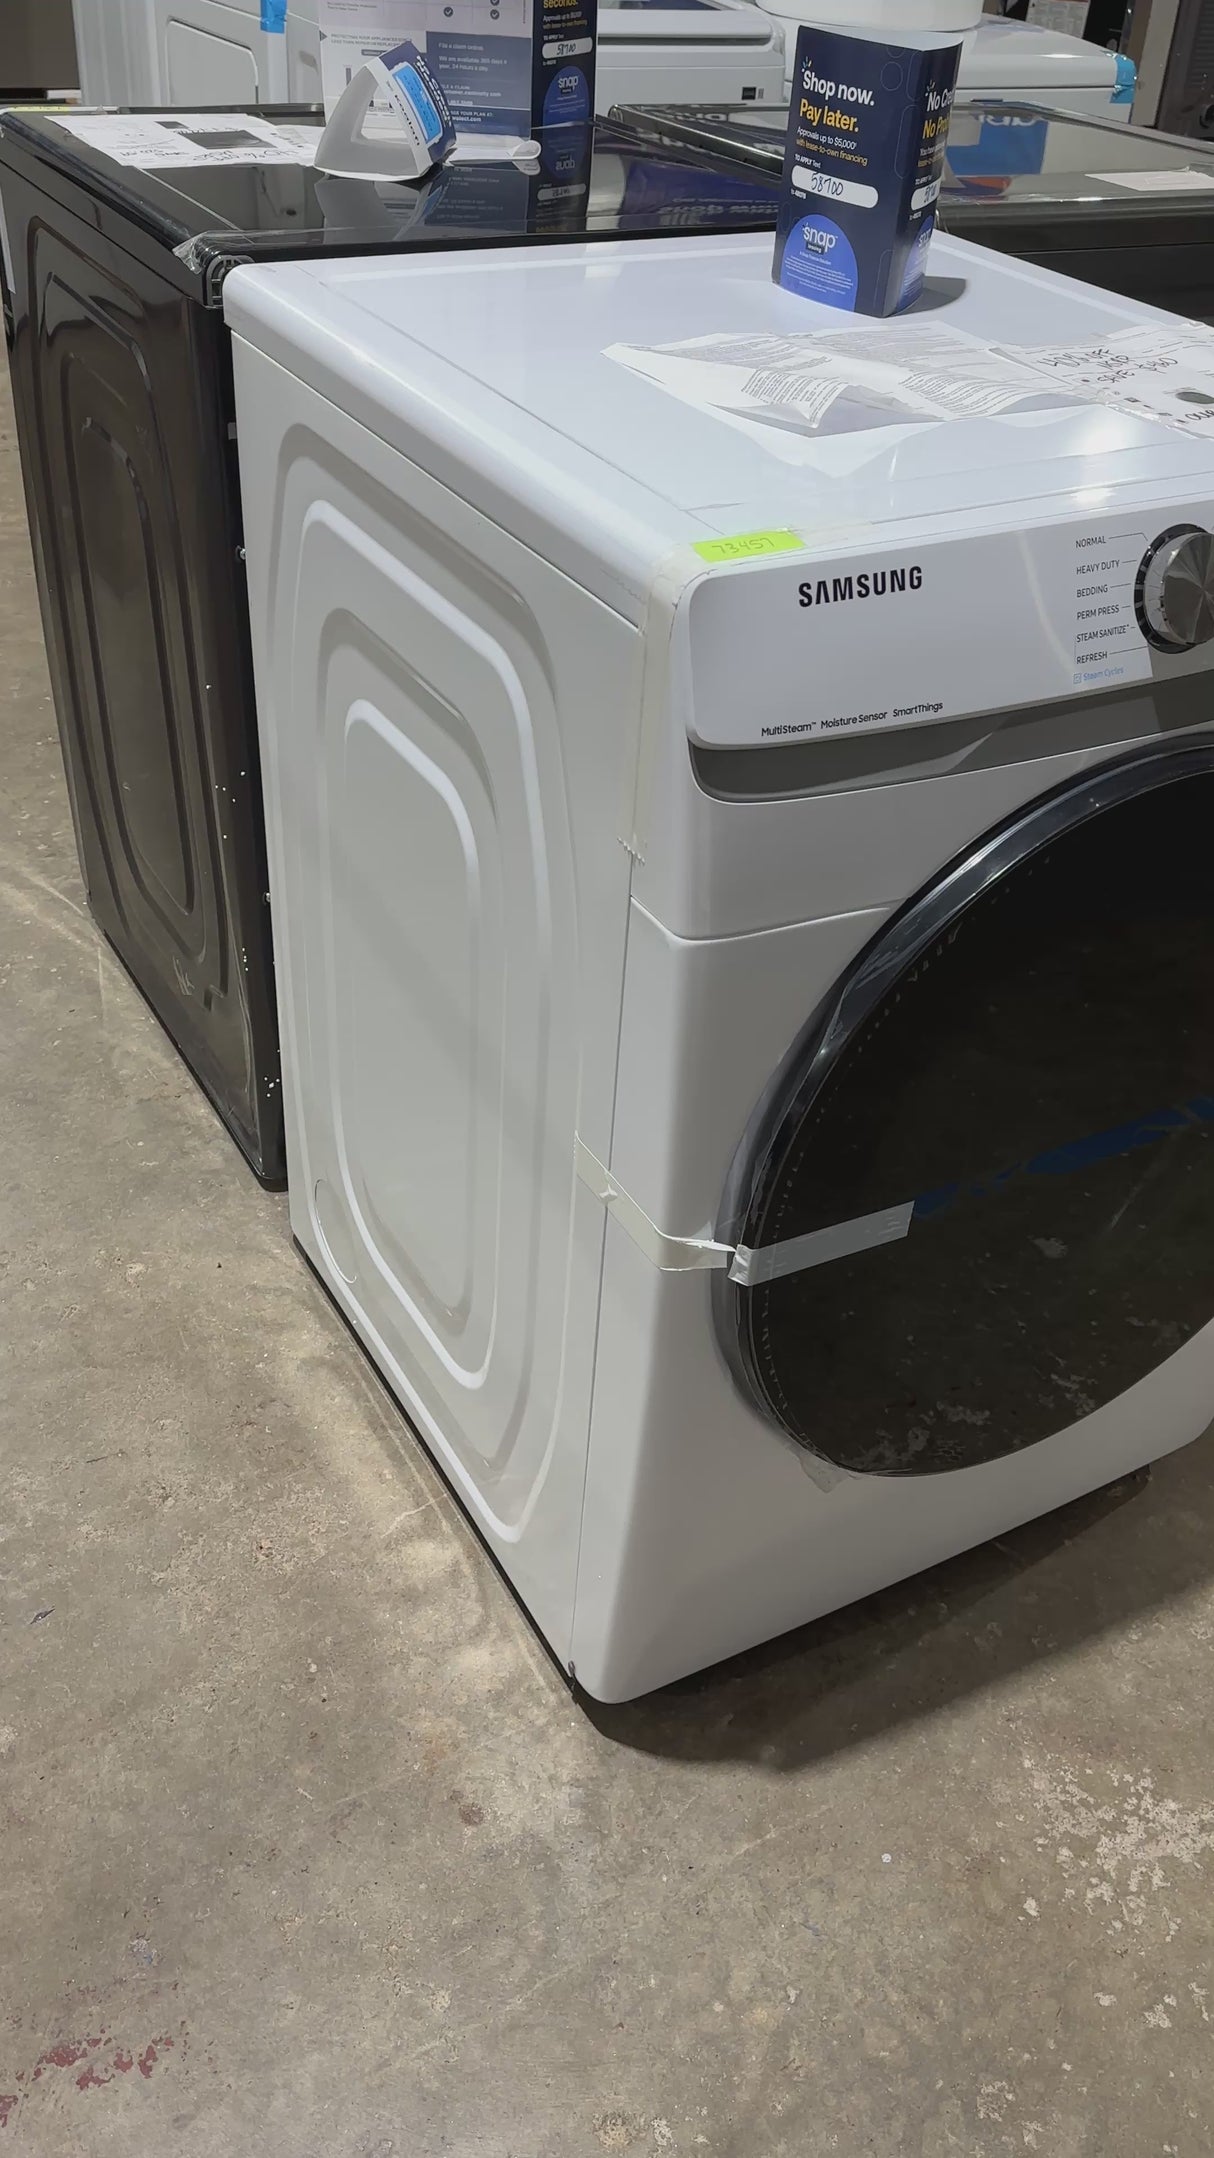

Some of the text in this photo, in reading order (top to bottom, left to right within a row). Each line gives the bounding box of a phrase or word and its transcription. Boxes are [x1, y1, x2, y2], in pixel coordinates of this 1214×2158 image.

[802, 70, 875, 106] Shop now.
[926, 90, 940, 112] No
[800, 99, 860, 132] Pay later.
[797, 126, 820, 141] Approvals
[820, 133, 827, 144] up
[828, 135, 834, 145] to
[922, 118, 936, 140] No
[840, 150, 869, 167] financing
[712, 538, 775, 555] 73457
[1076, 536, 1106, 548] NORMAL
[1076, 560, 1120, 575] HEAVY DUTY
[798, 566, 923, 608] SAMSUNG
[1076, 584, 1108, 598] BEDDING
[1076, 604, 1120, 620] PERM PRESS
[1076, 630, 1099, 643] STEAM
[1076, 652, 1108, 664] REFRESH
[1083, 666, 1124, 681] Steam Cycles
[820, 715, 858, 730] Moisture
[858, 711, 888, 724] Sensor
[892, 701, 943, 718] SmartThings
